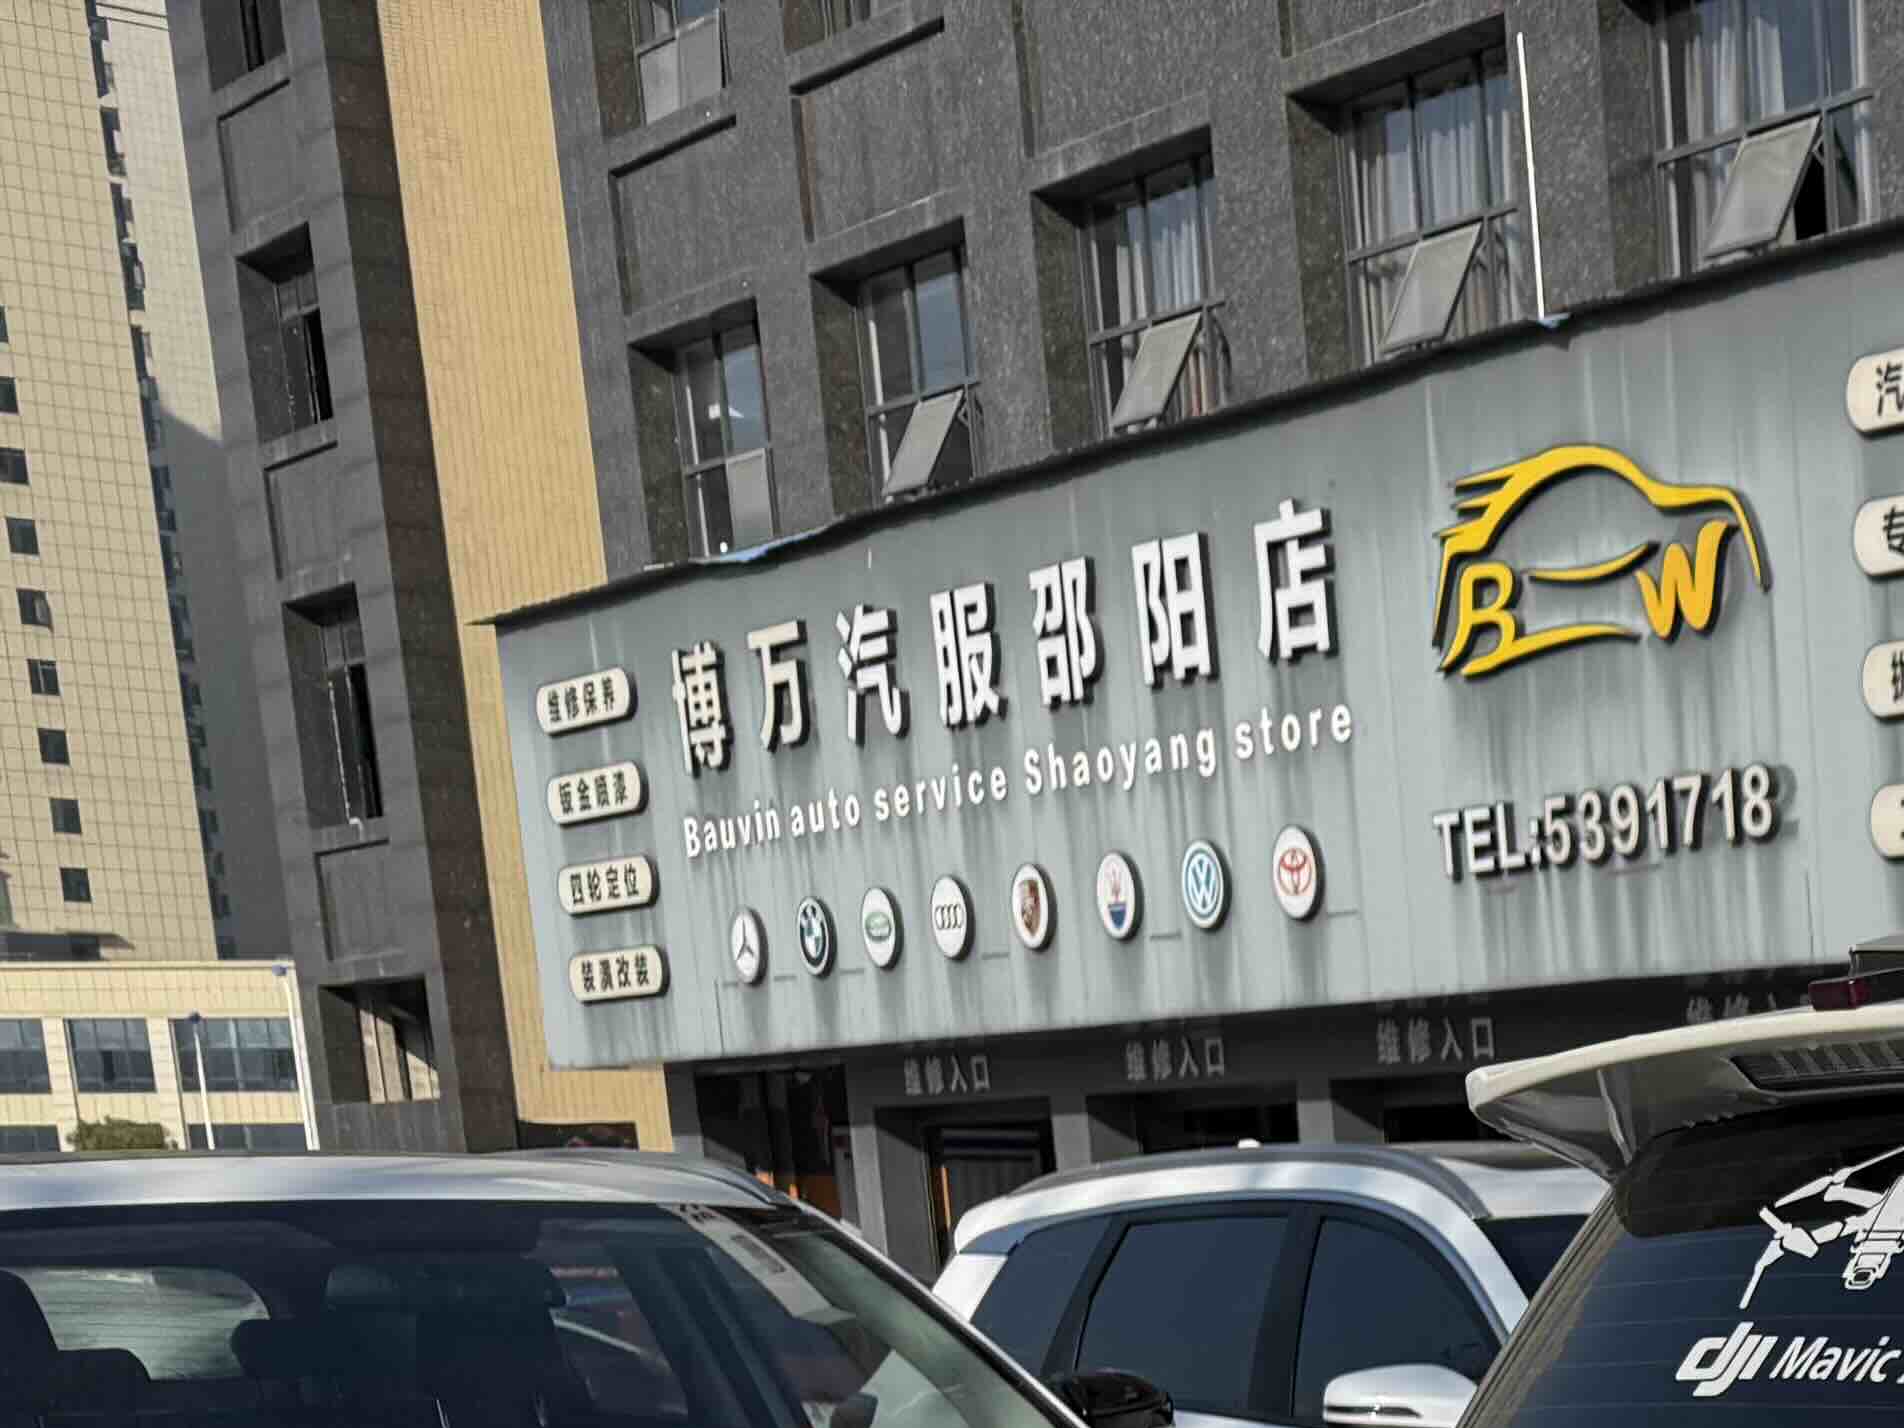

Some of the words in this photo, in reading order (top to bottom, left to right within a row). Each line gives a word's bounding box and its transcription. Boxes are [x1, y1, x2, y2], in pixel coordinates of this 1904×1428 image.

[672, 498, 1334, 776] 博万汽服邵阳店
[683, 806, 781, 858] Bauvin
[790, 793, 861, 836] auto
[874, 767, 1008, 821] service
[1024, 725, 1217, 794] Shaoyang
[1234, 701, 1353, 760] store
[1434, 763, 1776, 882] TEL:5391718
[569, 862, 640, 905] 四轮定位
[1125, 1036, 1226, 1083] 维修入口
[1376, 1016, 1497, 1065] 维修入口
[903, 1054, 991, 1097] 维修入口
[1770, 1336, 1901, 1384] Mavic
